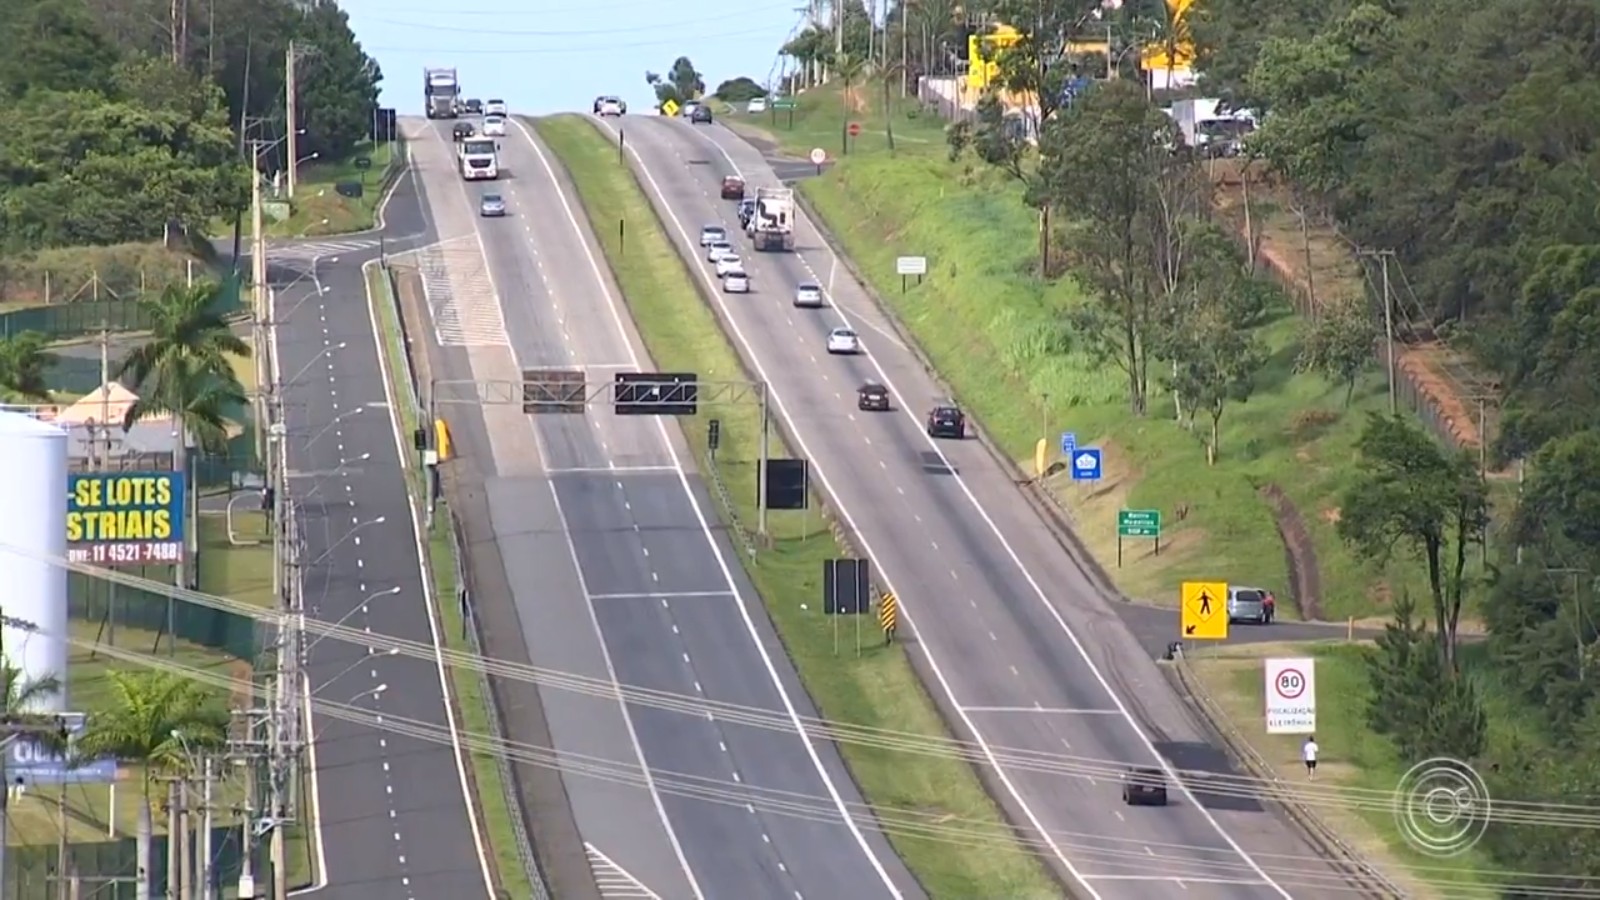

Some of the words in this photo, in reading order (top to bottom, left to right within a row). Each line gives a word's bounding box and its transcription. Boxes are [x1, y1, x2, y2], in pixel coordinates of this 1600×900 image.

[106, 477, 171, 506] LOTES
[66, 509, 171, 541] STRIAIS
[93, 545, 105, 561] 11
[1281, 676, 1300, 688] 80
